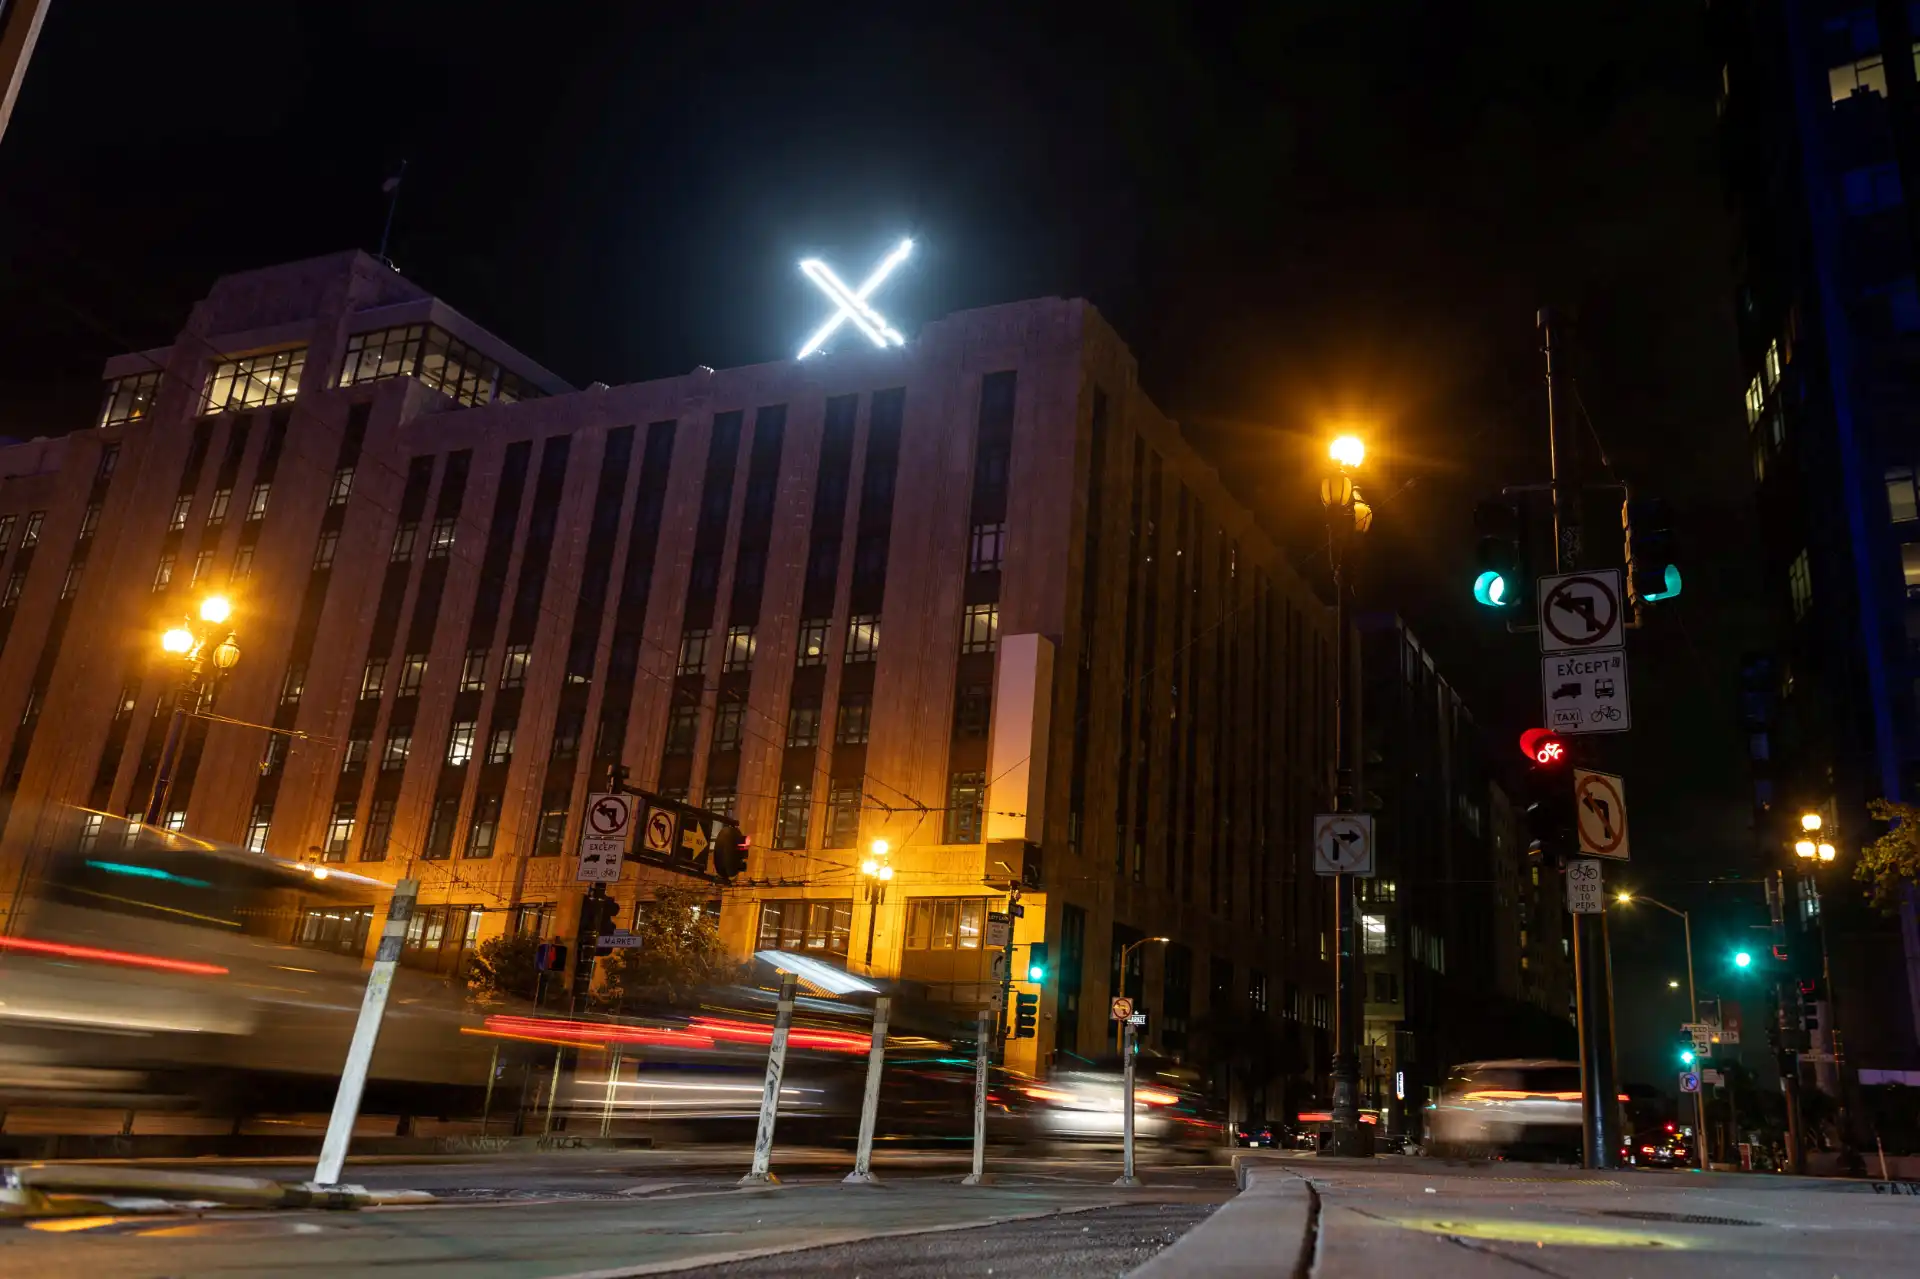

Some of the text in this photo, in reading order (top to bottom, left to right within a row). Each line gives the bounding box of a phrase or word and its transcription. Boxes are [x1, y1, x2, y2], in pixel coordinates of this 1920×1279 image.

[797, 238, 912, 361] X
[1557, 660, 1609, 676] EXCEPT
[1556, 713, 1579, 721] TAXI
[589, 843, 617, 852] EXCEPT
[1573, 884, 1597, 892] YIELD
[1580, 893, 1591, 901] TO
